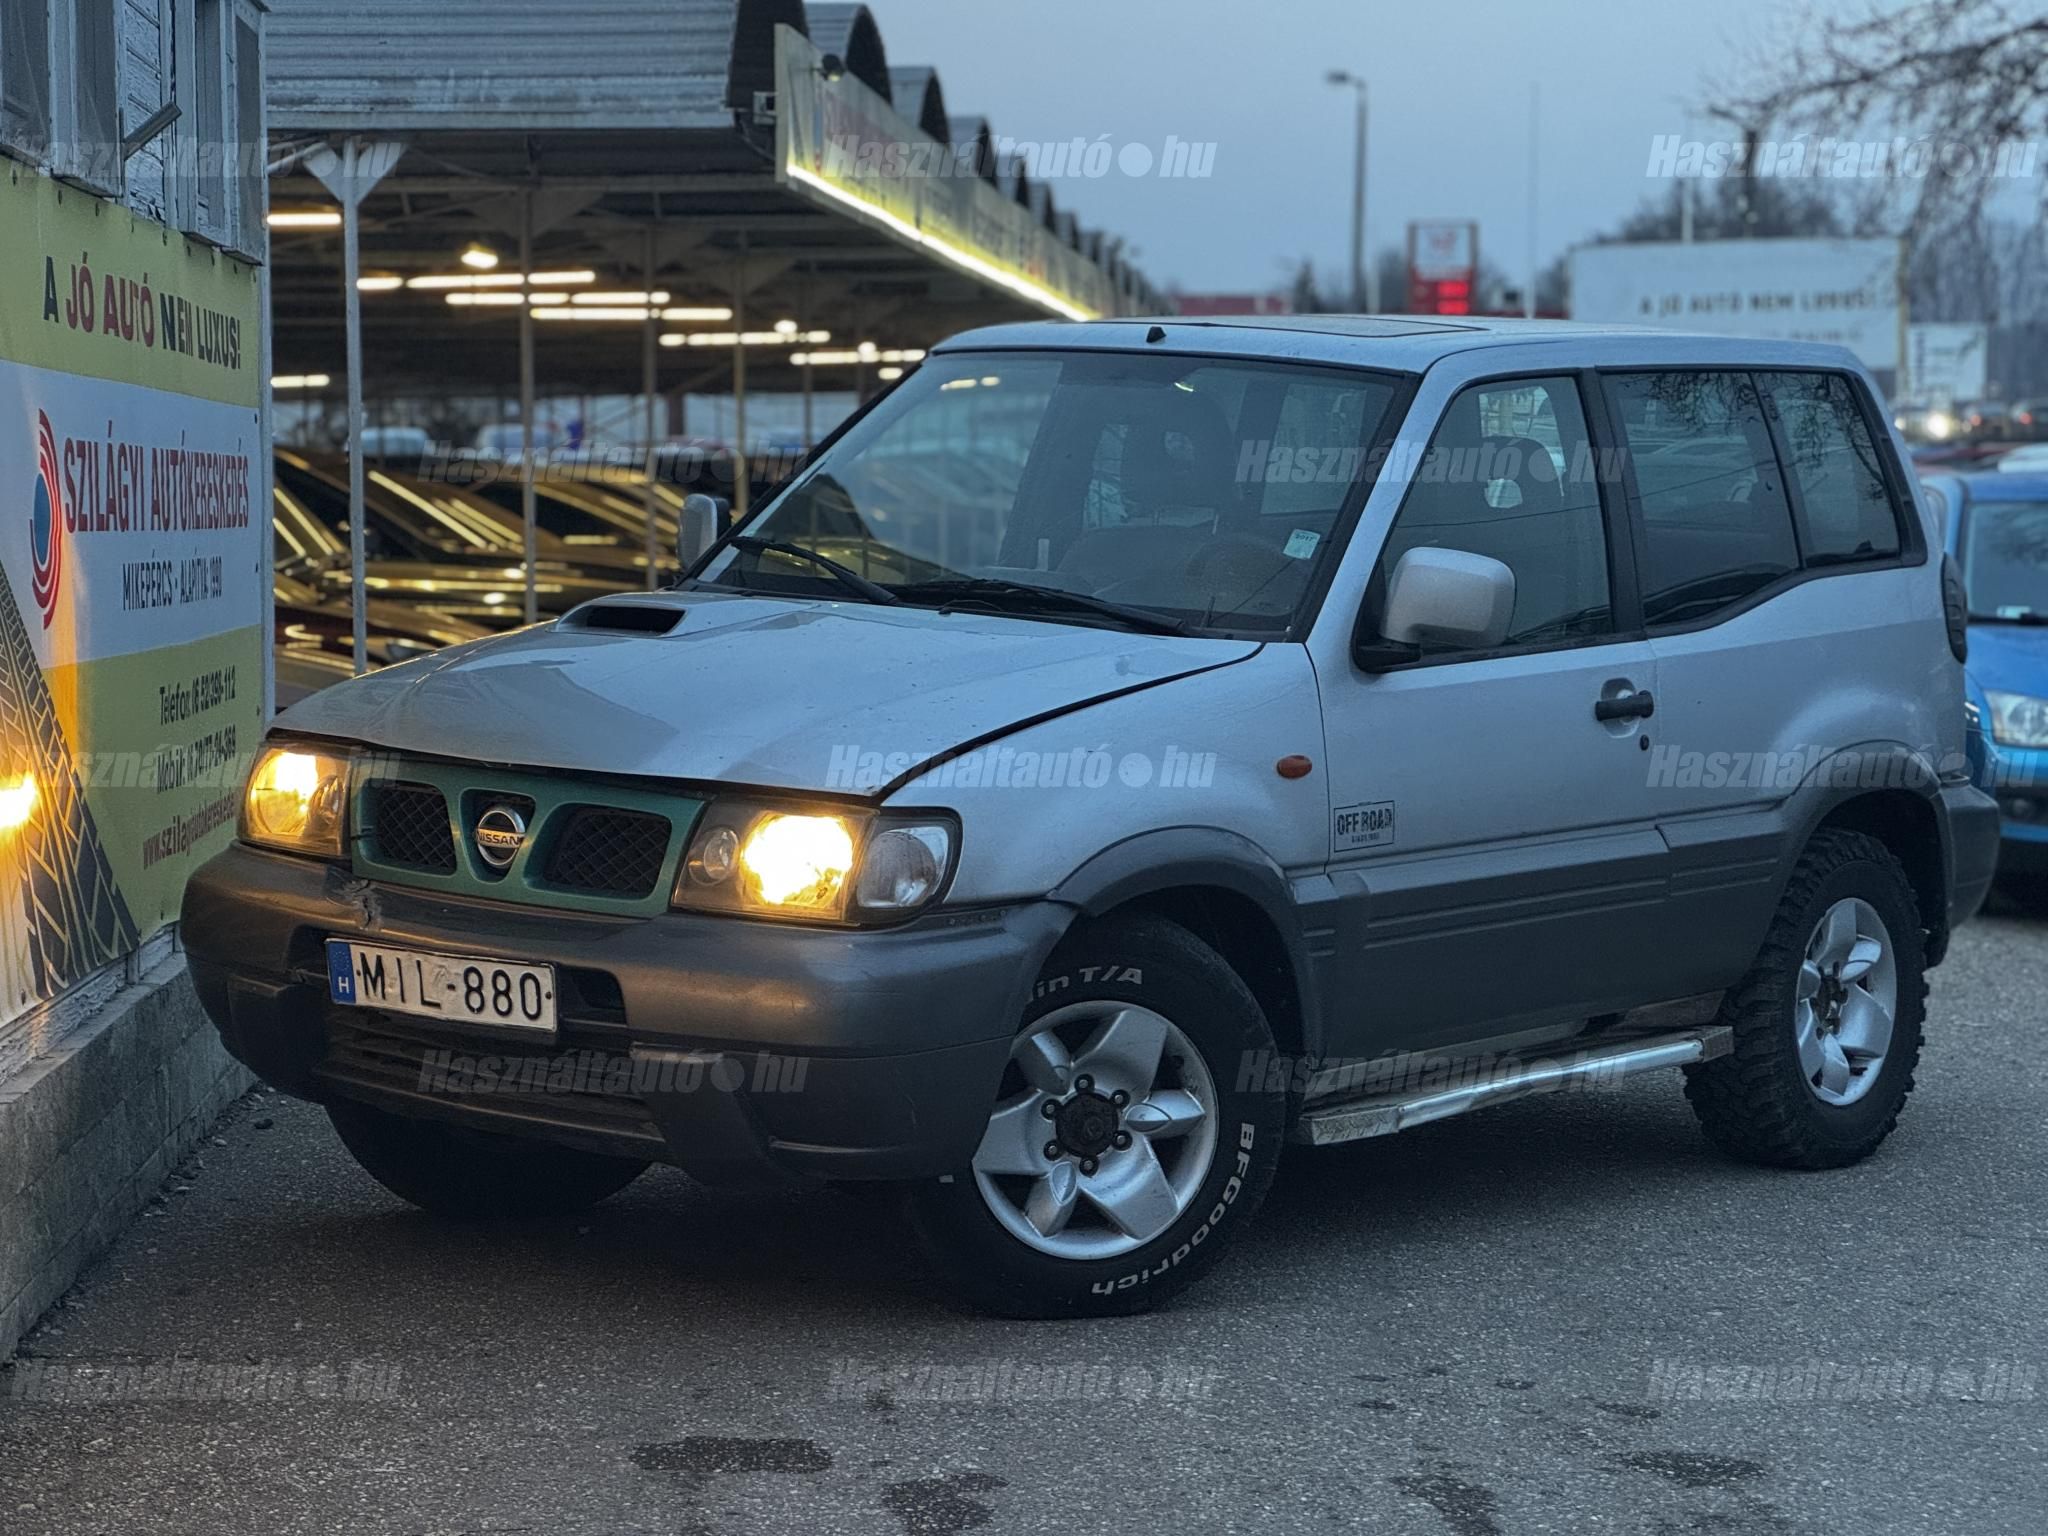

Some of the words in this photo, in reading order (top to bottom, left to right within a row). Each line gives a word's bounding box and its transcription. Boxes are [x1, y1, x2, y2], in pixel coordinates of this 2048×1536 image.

[43, 256, 59, 323] A
[65, 252, 94, 333] JÓ
[103, 272, 155, 348] AUTÓ
[159, 292, 194, 357] NEM
[196, 305, 241, 370] LUXUS!
[63, 420, 146, 534] SZILÁGYI
[150, 429, 249, 532] AUTÓKERESKEDÉS
[122, 549, 173, 612] MIKEPÉRCS
[477, 828, 521, 848] NISSAN
[1337, 812, 1359, 835] OFF
[1361, 808, 1392, 832] ROAD
[338, 977, 350, 994] H
[360, 952, 542, 1021] MIL-880
[1079, 965, 1144, 986] T/A
[1091, 1122, 1256, 1296] BFGoodrich
